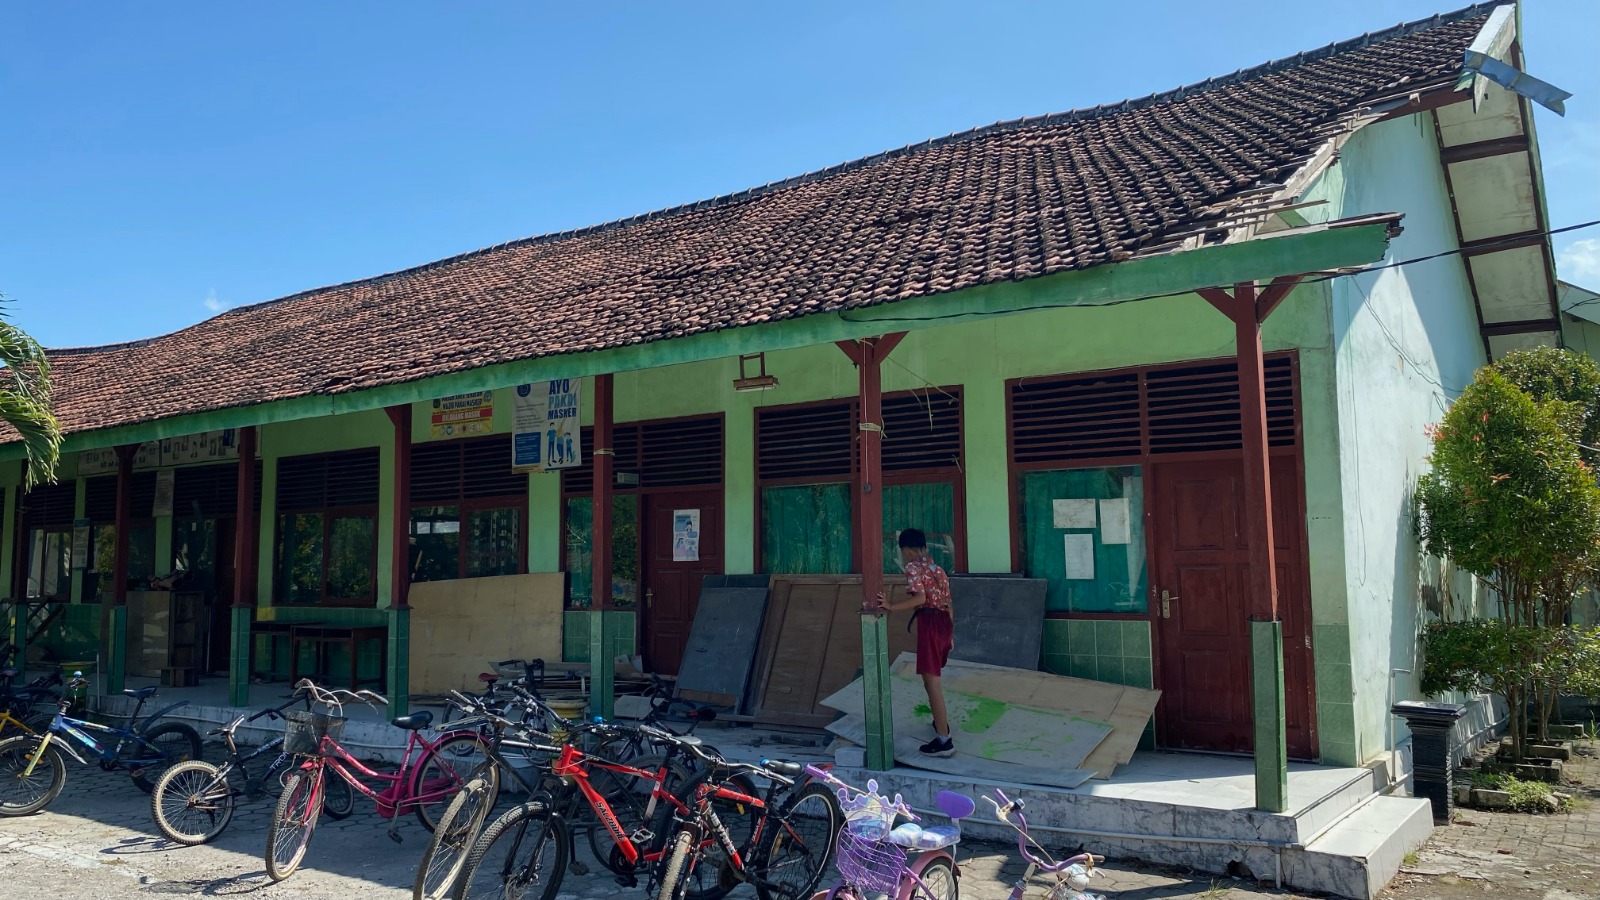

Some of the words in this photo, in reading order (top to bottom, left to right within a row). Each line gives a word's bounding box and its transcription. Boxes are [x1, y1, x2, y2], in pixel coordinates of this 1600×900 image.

[549, 379, 570, 395] AYO
[548, 393, 577, 409] PAKAI
[547, 407, 577, 420] MASKER
